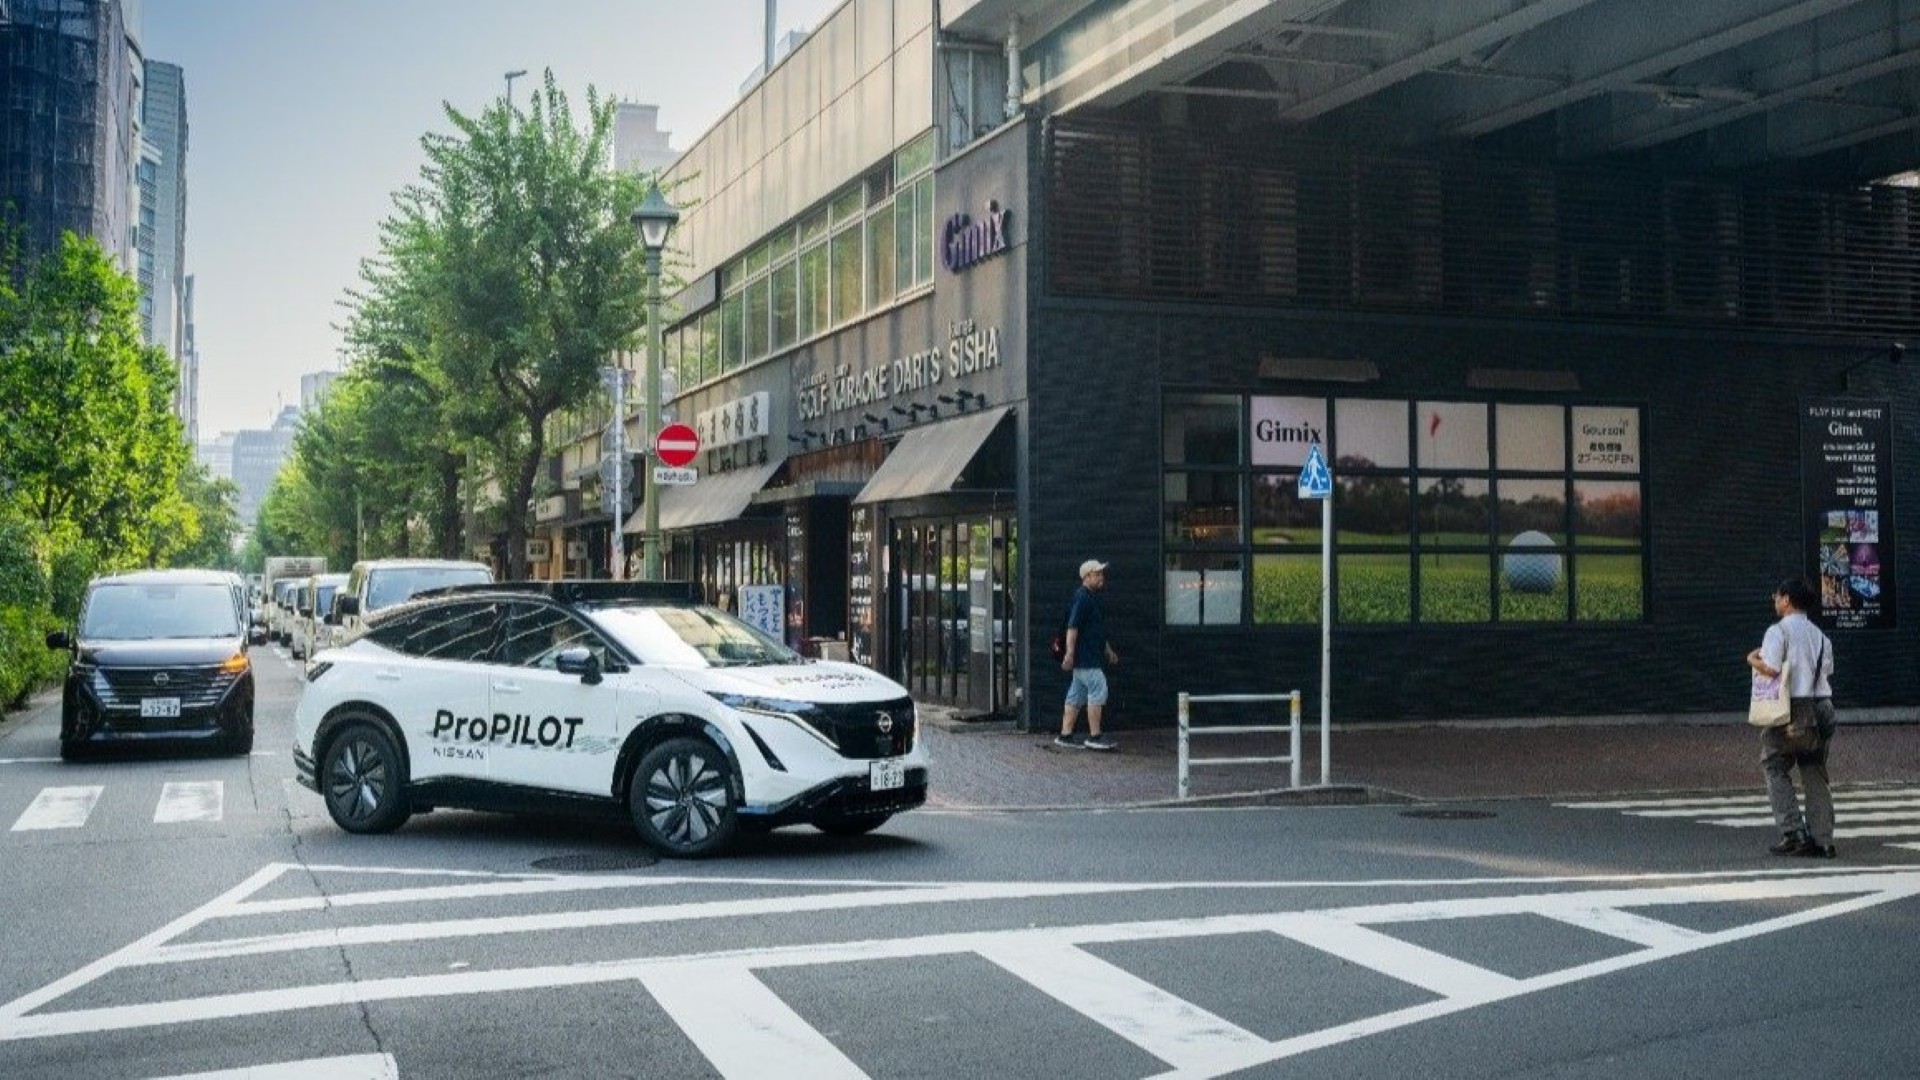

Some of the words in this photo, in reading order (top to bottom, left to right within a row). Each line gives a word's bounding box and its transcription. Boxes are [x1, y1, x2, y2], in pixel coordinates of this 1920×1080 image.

[941, 199, 1010, 272] Gimix
[799, 383, 828, 421] GOLF
[832, 363, 889, 412] KARAOKE
[893, 346, 940, 395] DARTS
[949, 325, 999, 379] SISHA
[1256, 419, 1321, 443] Gimix
[1827, 421, 1864, 436] Gimix
[433, 709, 584, 748] ProPILOT
[433, 747, 485, 760] NISSAN
